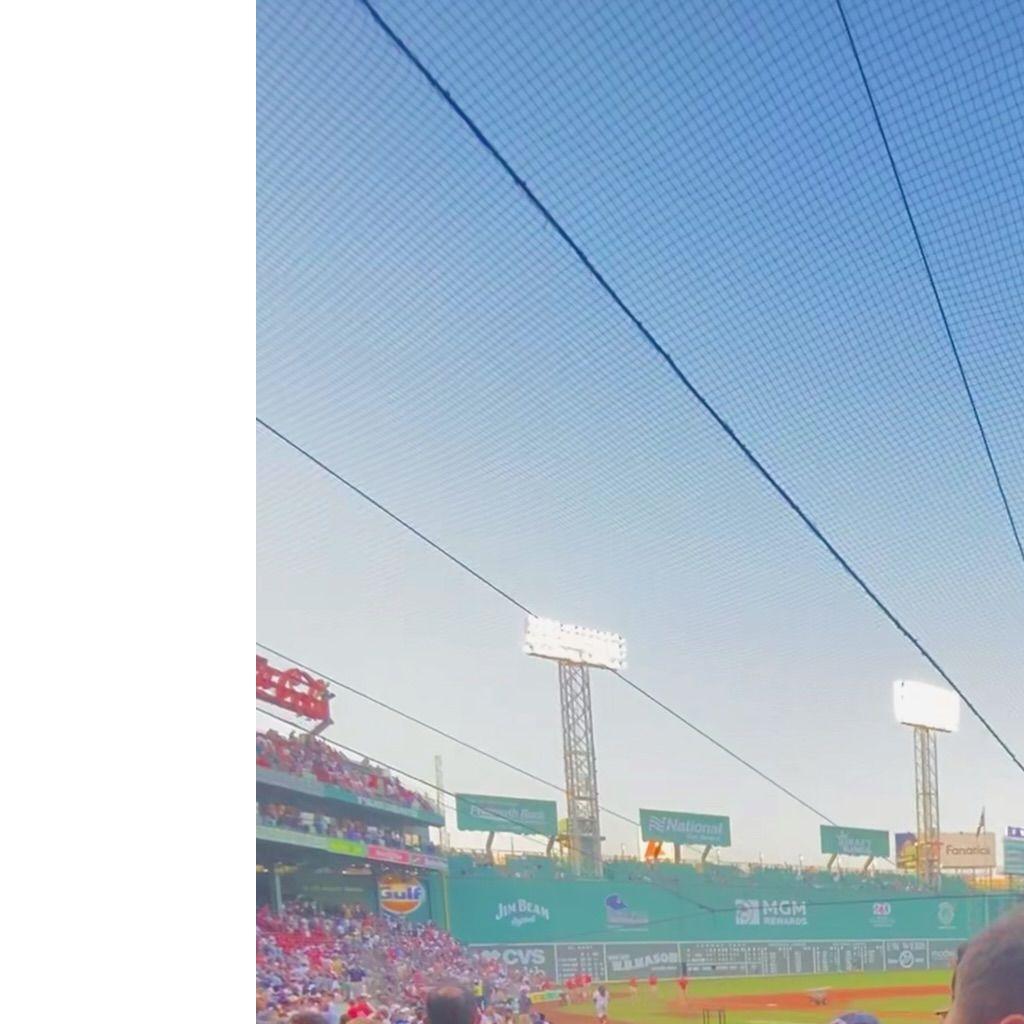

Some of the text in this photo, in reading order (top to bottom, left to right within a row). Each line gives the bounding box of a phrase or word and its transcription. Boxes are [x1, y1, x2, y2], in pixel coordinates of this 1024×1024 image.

[666, 817, 724, 833] National
[381, 885, 422, 900] Gulf
[495, 899, 550, 920] JIM BEAM
[763, 900, 807, 915] MGM
[502, 949, 545, 965] CVS
